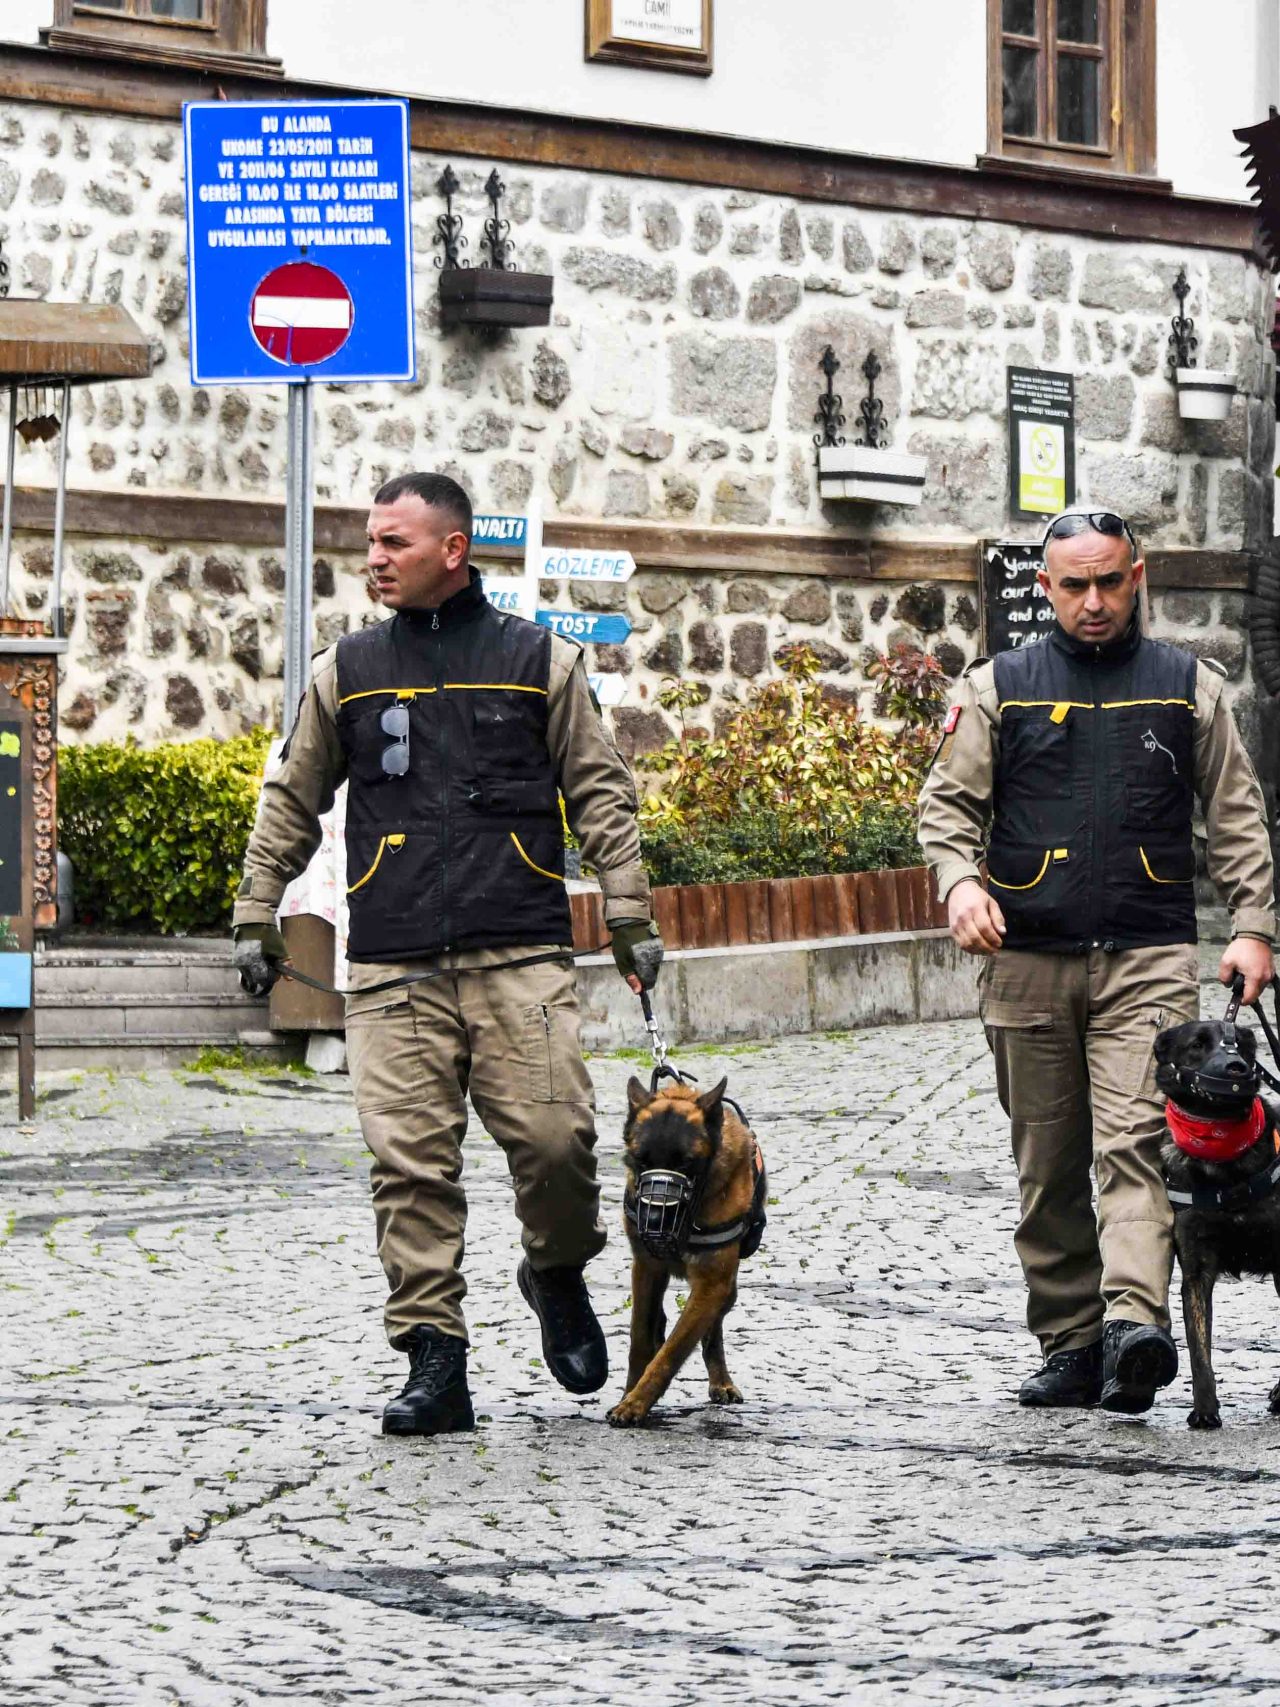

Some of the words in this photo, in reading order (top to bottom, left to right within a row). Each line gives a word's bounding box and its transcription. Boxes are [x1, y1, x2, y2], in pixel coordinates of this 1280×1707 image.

[262, 116, 278, 132] BU
[284, 116, 331, 132] ALANDA
[221, 139, 263, 156] UKOME
[269, 139, 333, 156] 23/05/2011
[337, 136, 372, 154] TARİH
[218, 163, 234, 178] VE
[240, 162, 285, 178] 2011/06
[290, 161, 326, 178] SAYILI
[331, 160, 378, 177] KARARI
[200, 183, 241, 202] GEREĞİ
[246, 184, 279, 201] 10.00
[284, 183, 302, 200] İLE
[344, 181, 398, 199] SAATLERİ
[225, 207, 285, 224] ARASINDA
[291, 207, 321, 223] YAYA
[326, 203, 373, 222] BÖLGESİ
[208, 230, 286, 247] UYGULAMASI
[291, 228, 391, 245] YAPILMAKTADIR.
[473, 517, 523, 539] VALTI
[1002, 585, 1032, 599] our
[1008, 607, 1032, 622] and
[549, 616, 599, 634] TOST
[1144, 740, 1156, 752] K9
